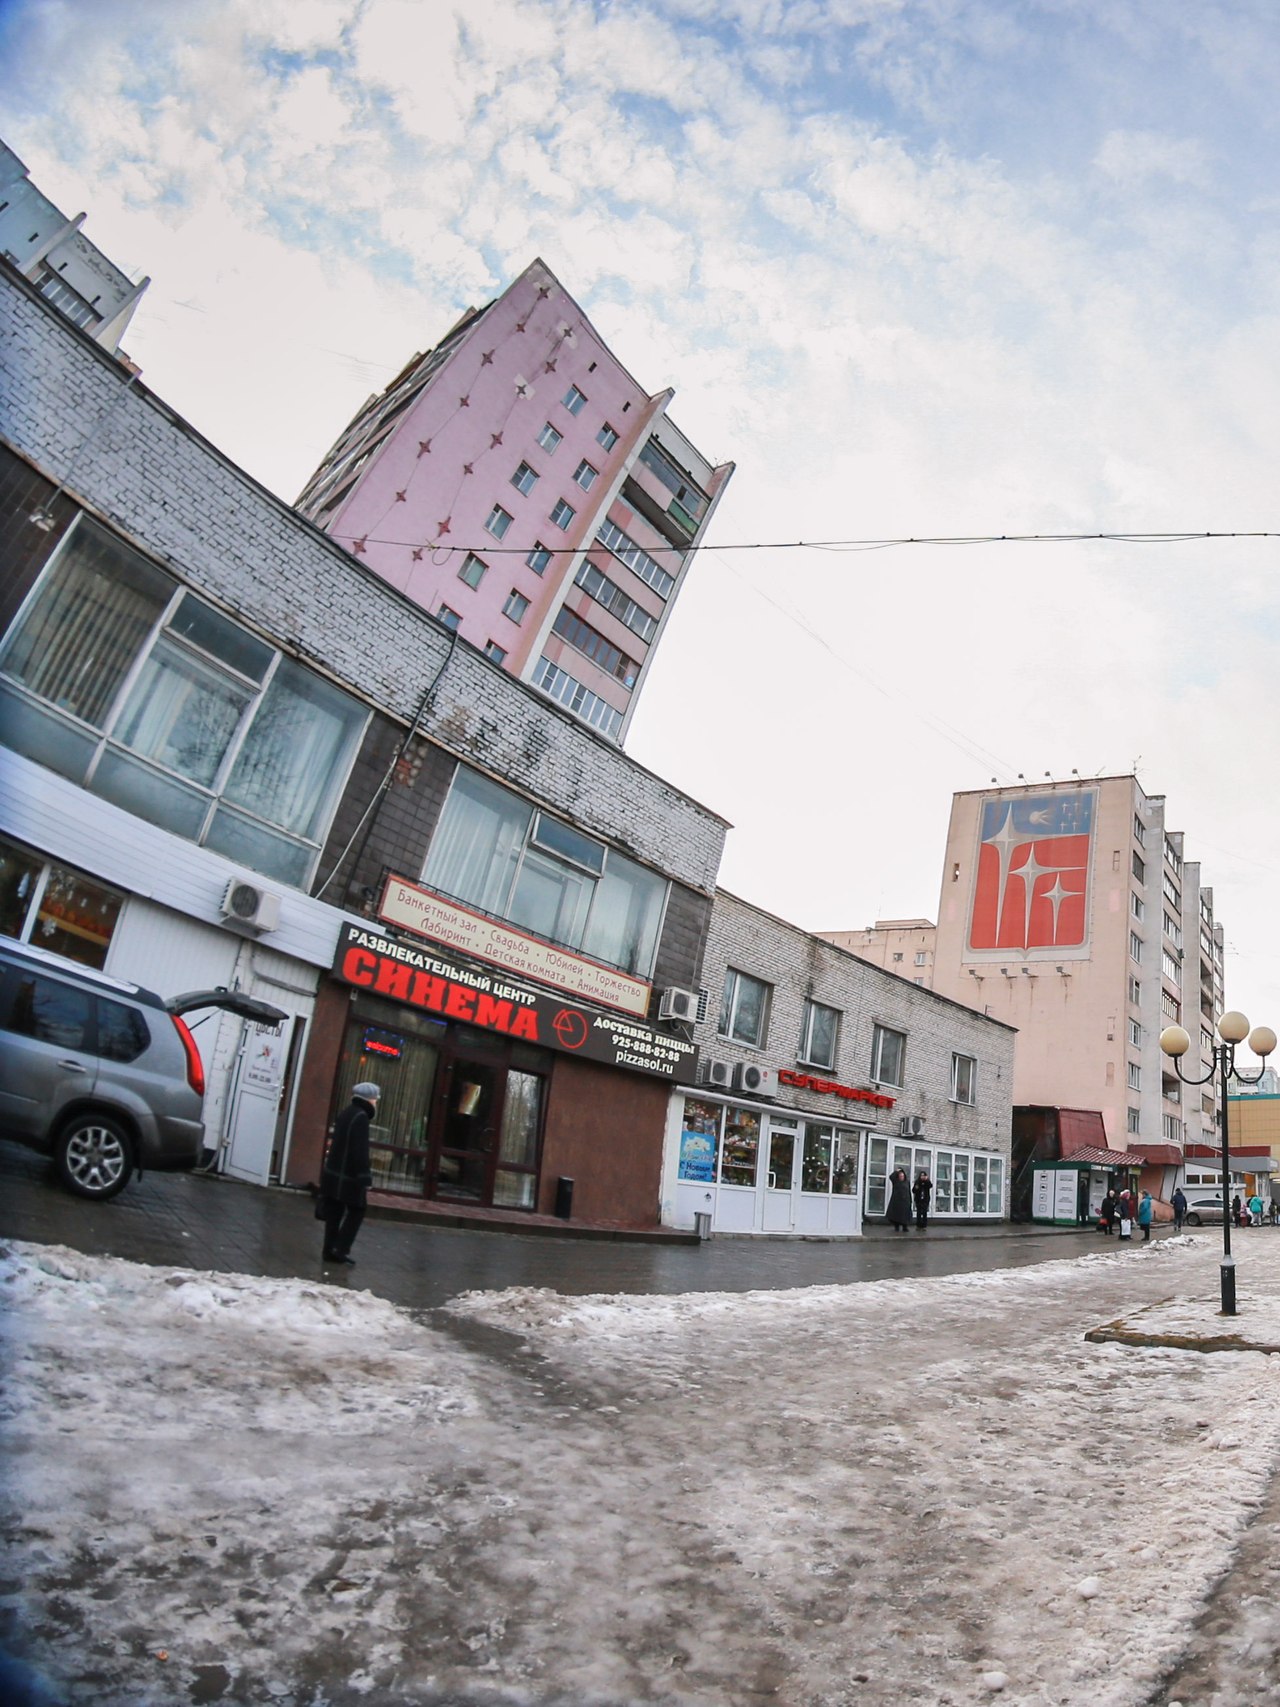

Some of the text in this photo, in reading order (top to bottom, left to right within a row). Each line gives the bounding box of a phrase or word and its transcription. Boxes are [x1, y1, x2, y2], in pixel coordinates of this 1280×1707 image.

[348, 928, 536, 1006] РАЗВЛЕКАТЕЛЬНЫЙ ЦЕНТР
[397, 888, 641, 997] Банкетный зал Свадьба Юбилей Торжество
[420, 917, 620, 1003] Лабиринт Детская комната Анимация
[342, 947, 539, 1041] СИНЕМА
[593, 1017, 695, 1054] Доставка пиццы
[615, 1050, 673, 1074] pizzasol.ru
[778, 1068, 897, 1109] СУПЕРМАРКЕТ
